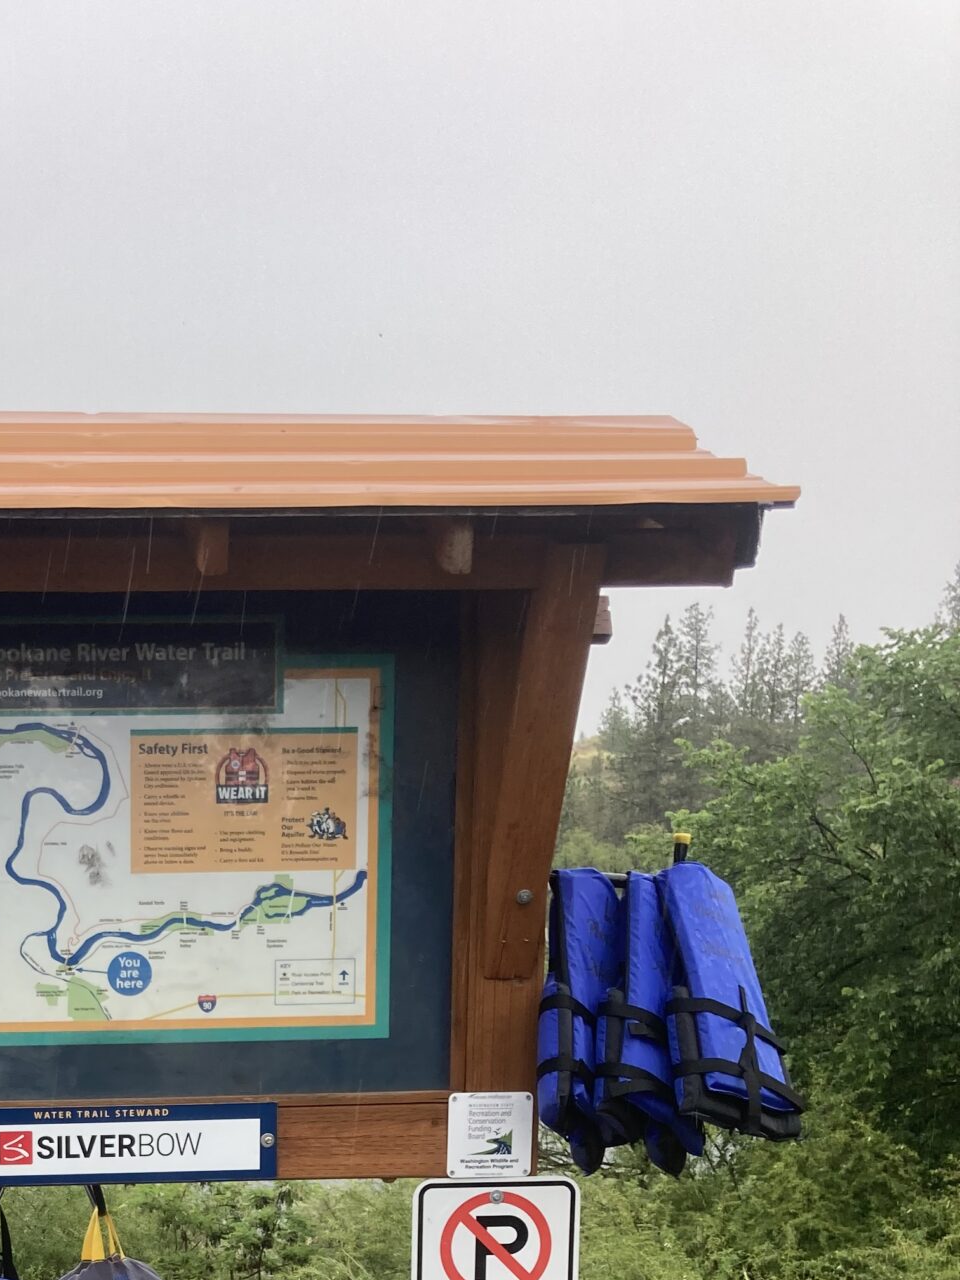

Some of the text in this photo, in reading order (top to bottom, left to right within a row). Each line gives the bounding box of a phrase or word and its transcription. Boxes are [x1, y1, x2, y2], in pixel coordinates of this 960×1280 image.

[77, 643, 129, 662] River
[135, 642, 197, 662] Water
[202, 642, 245, 661] Trail
[139, 742, 208, 758] Safety First
[218, 786, 267, 799] WEAR IT
[118, 957, 140, 968] You
[120, 970, 140, 978] are
[116, 978, 144, 988] here
[202, 1002, 212, 1010] 90
[34, 1108, 170, 1120] WATER TRAIL STEWARD
[36, 1132, 202, 1160] SILVERBOW
